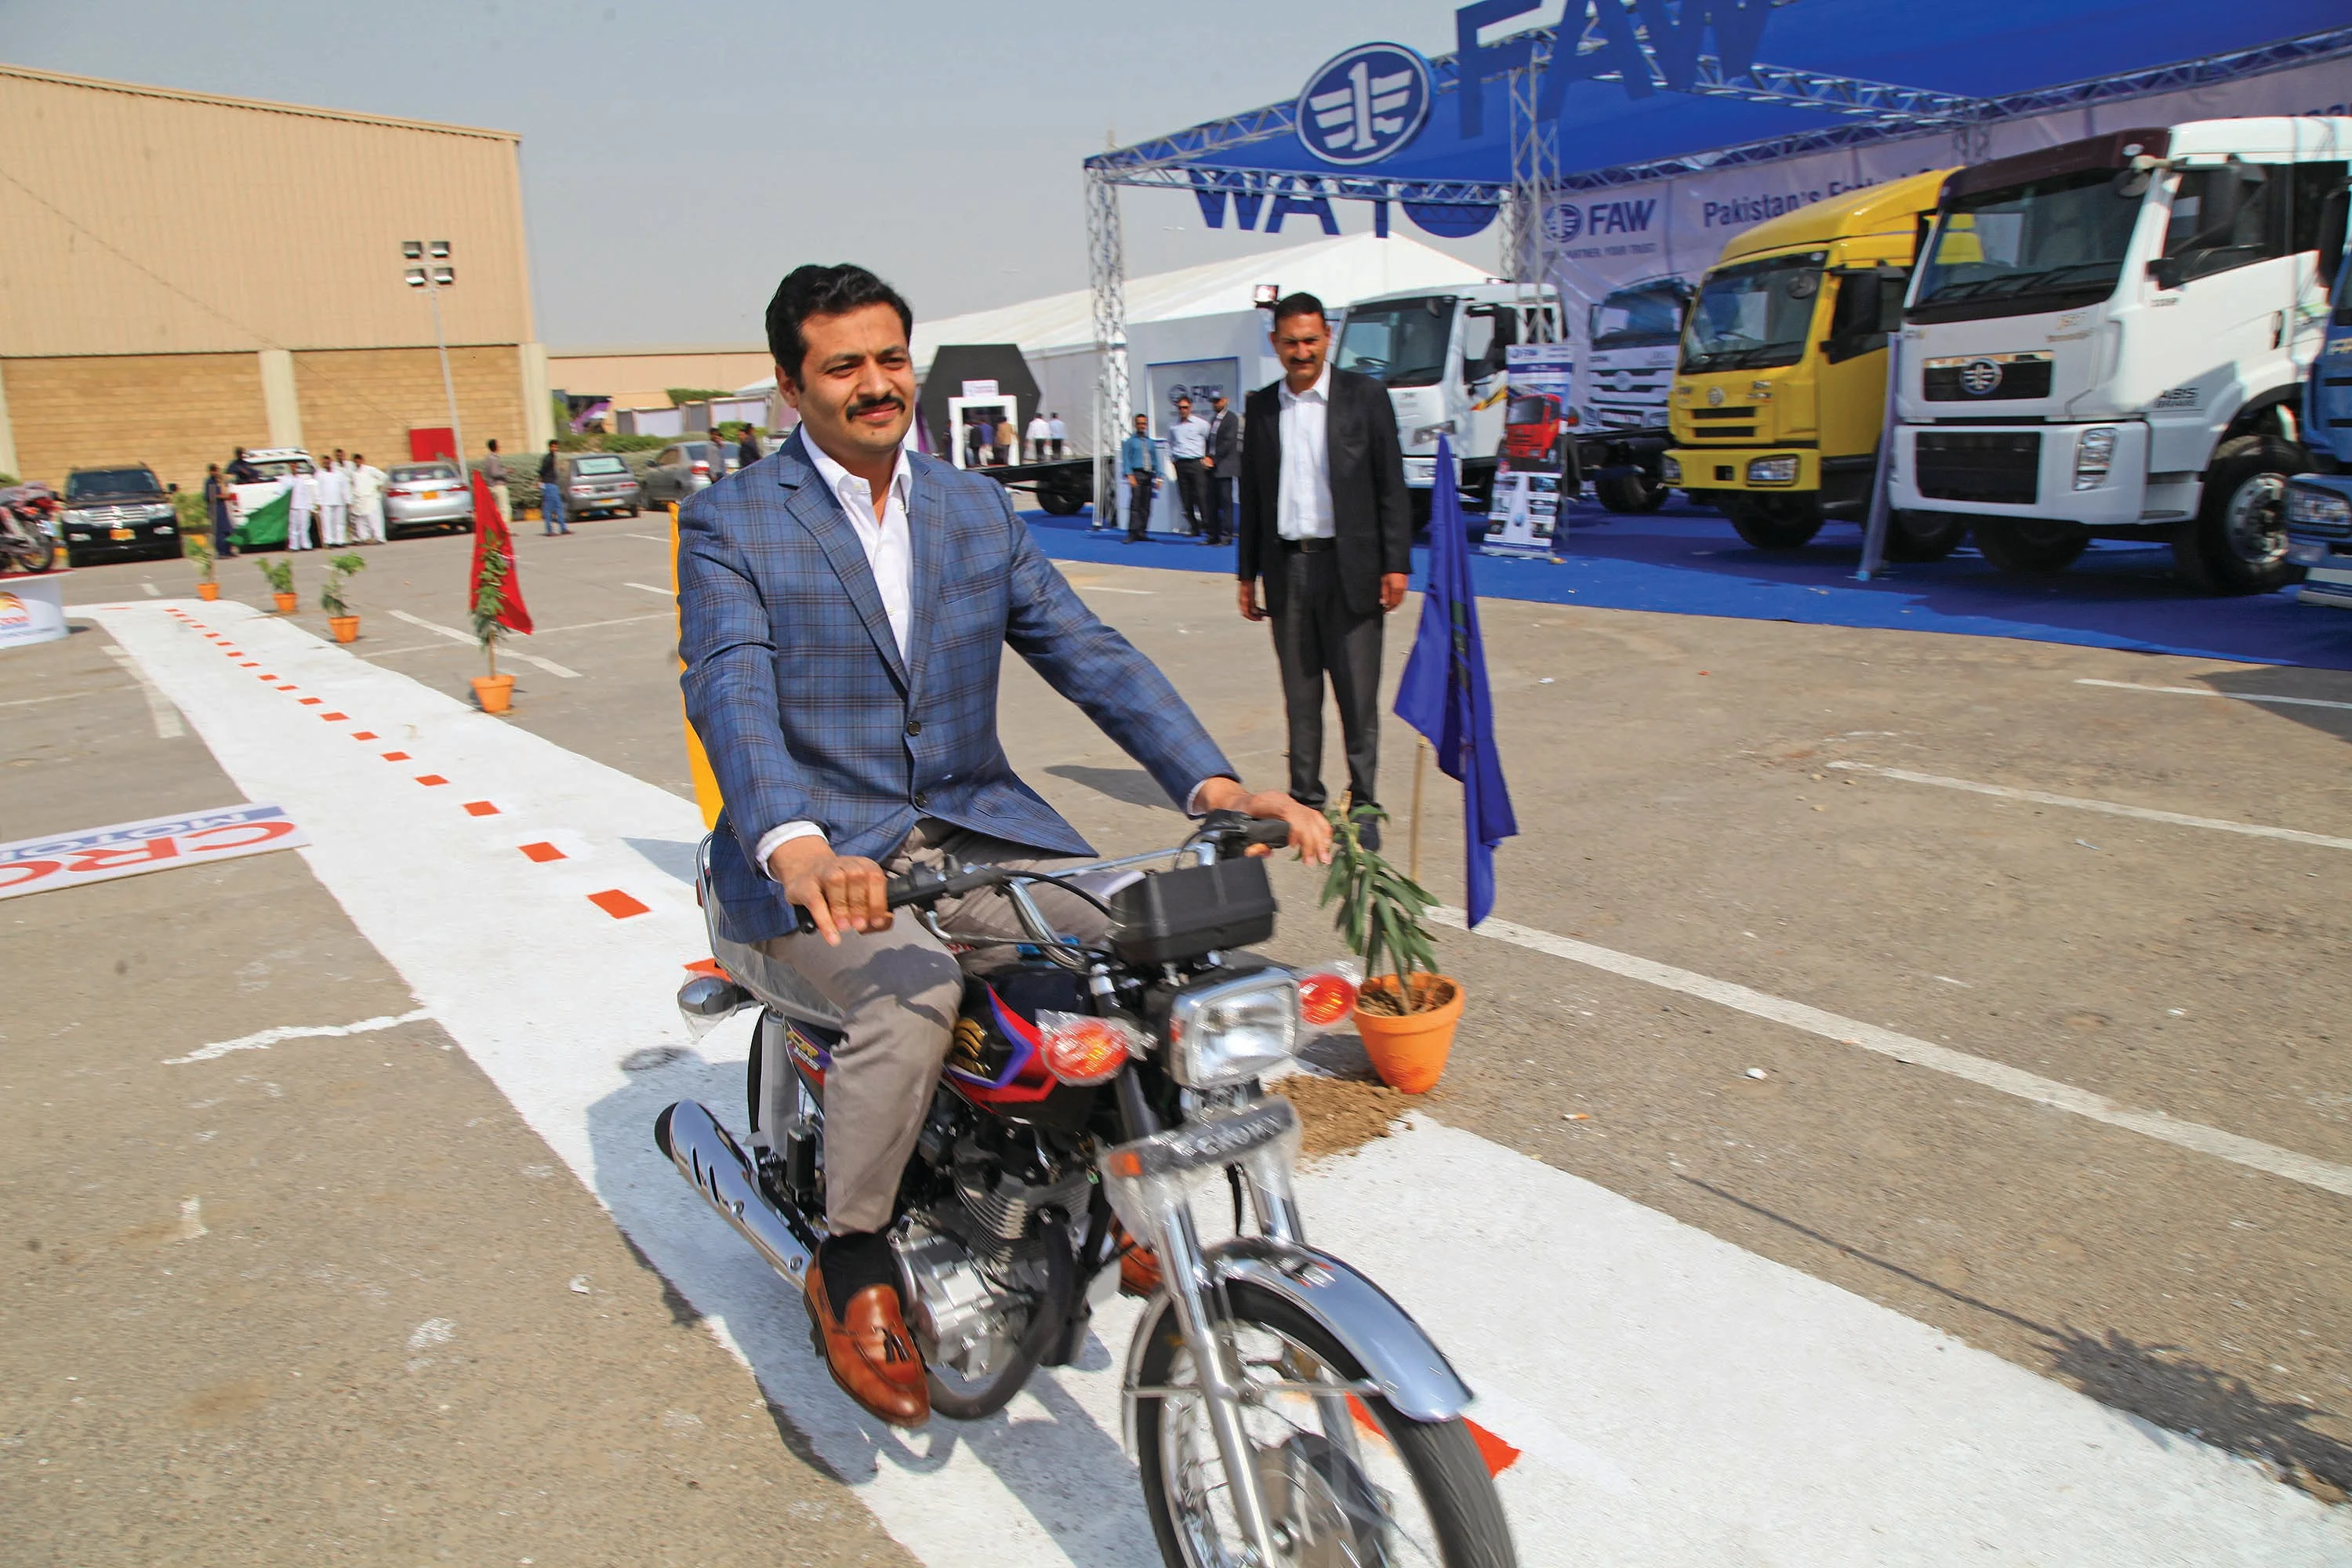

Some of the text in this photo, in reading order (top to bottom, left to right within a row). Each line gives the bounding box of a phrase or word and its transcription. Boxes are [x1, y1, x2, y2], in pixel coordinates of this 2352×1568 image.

[1456, 0, 1772, 140] FAW
[1588, 198, 1657, 235] FAW
[1703, 190, 1820, 228] Pakistan's
[2159, 387, 2200, 399] ABS
